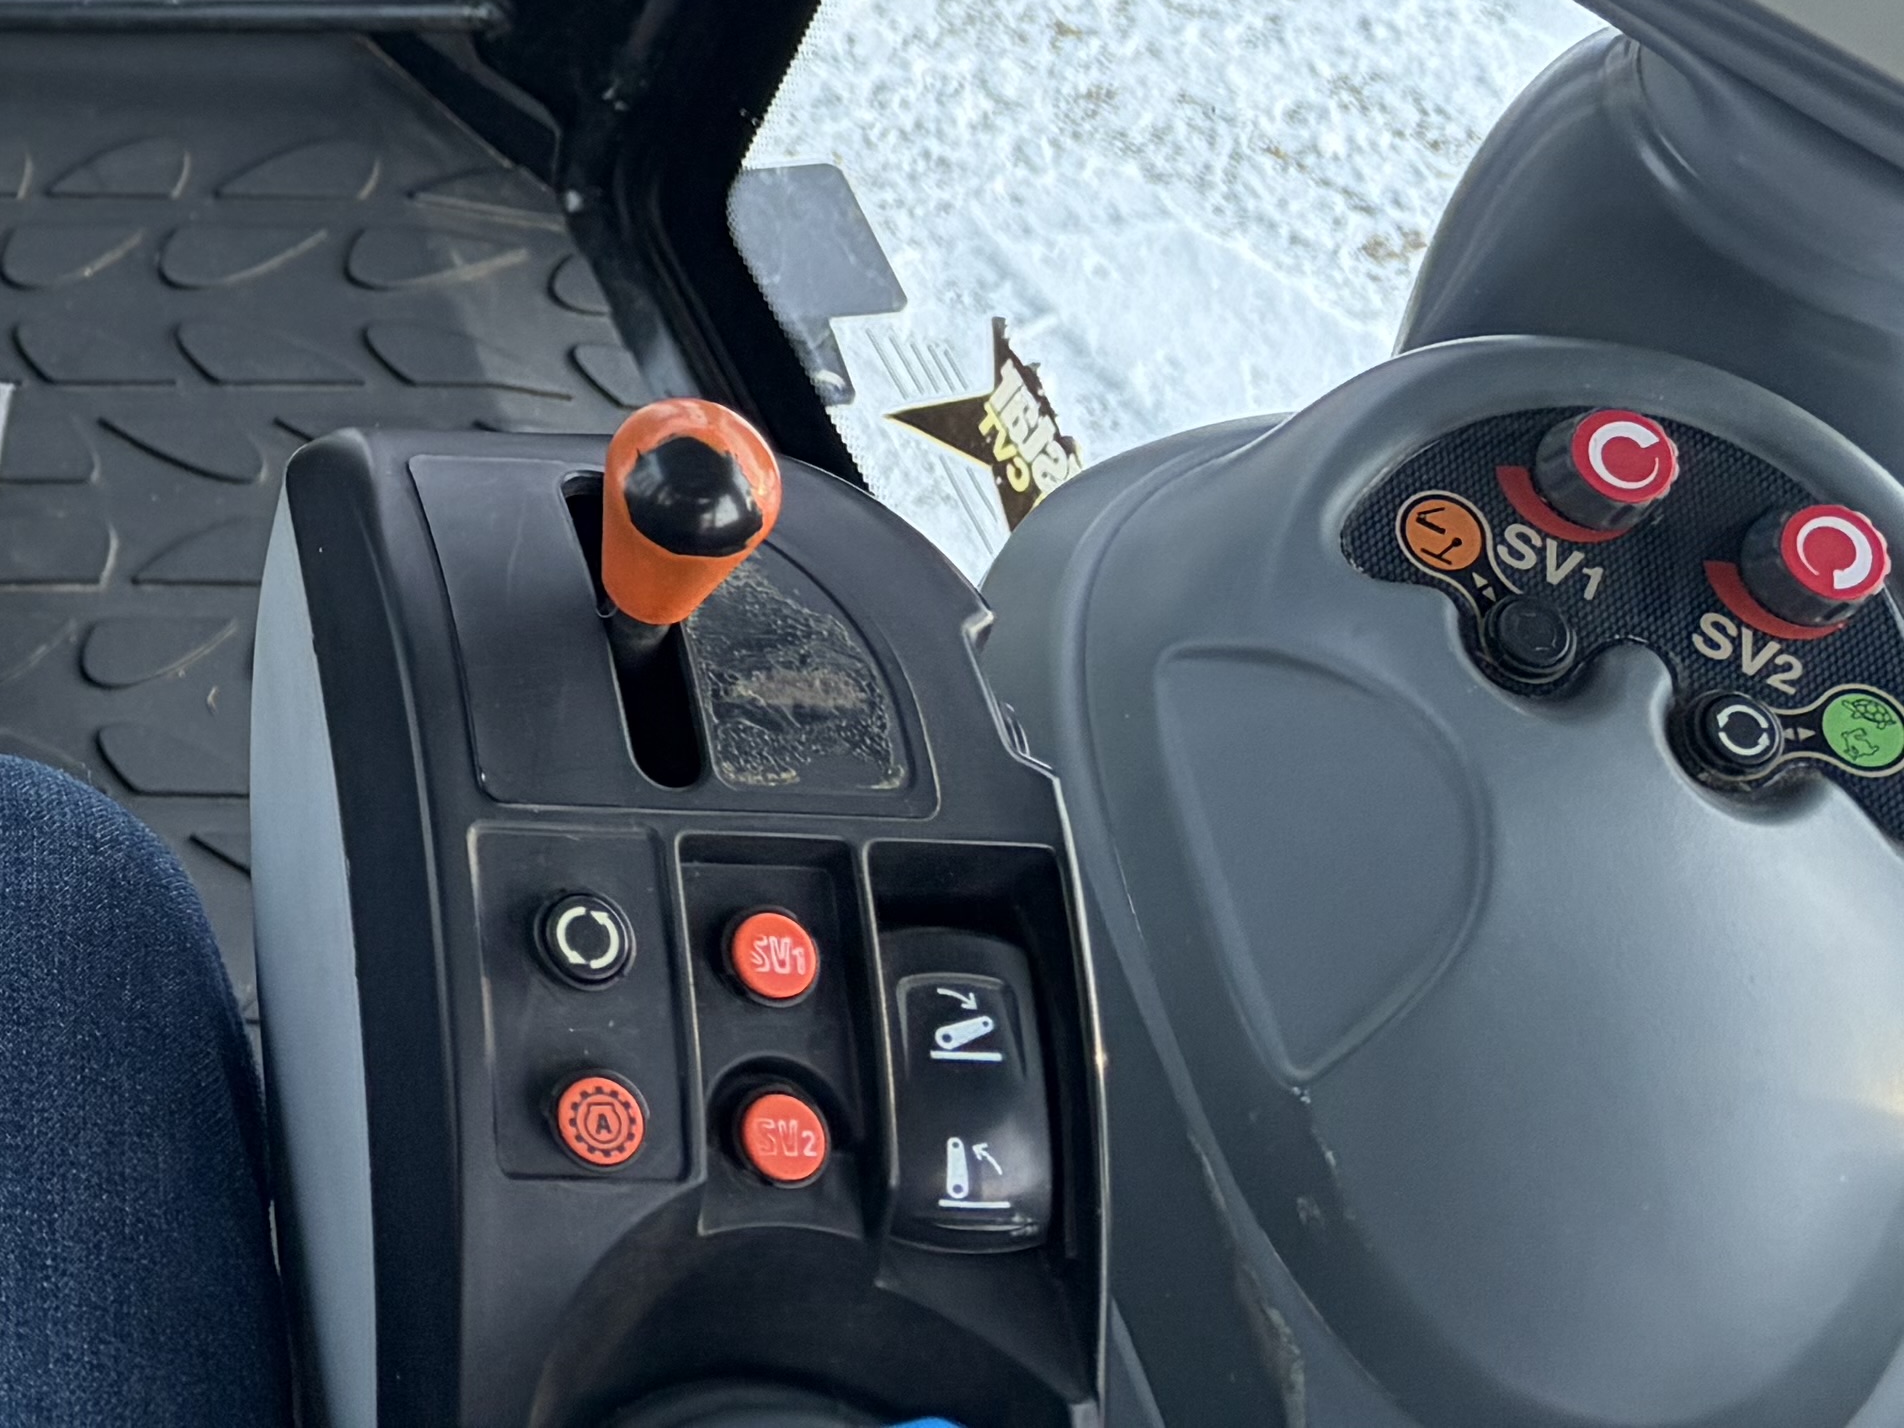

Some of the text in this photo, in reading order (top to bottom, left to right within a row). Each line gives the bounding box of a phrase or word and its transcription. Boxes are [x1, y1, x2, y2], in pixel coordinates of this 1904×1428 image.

[1496, 523, 1604, 601] SV1
[1692, 612, 1803, 695] SV2
[750, 935, 806, 976] SV1
[755, 1117, 818, 1157] SV2
